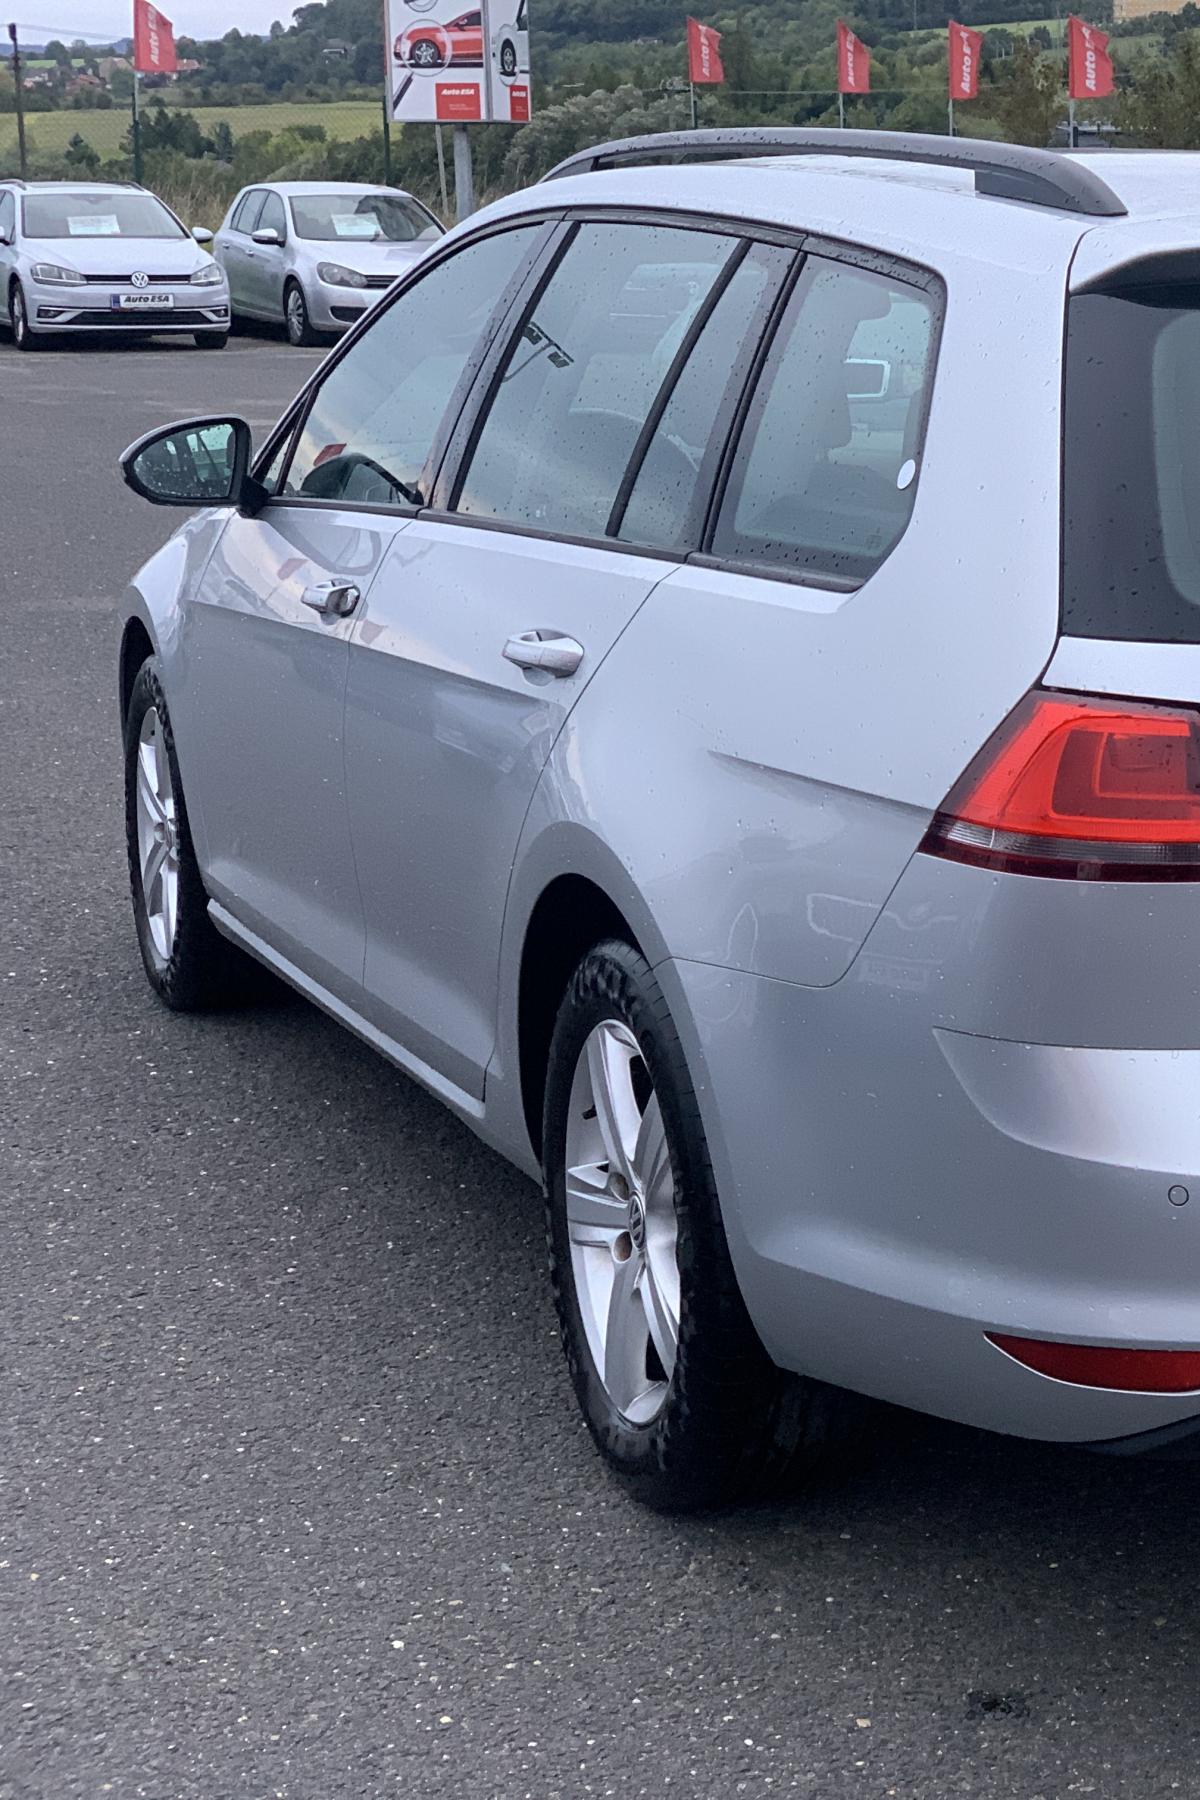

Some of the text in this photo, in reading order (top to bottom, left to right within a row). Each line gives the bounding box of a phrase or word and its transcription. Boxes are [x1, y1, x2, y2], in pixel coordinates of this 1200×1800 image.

[149, 31, 160, 65] Auto
[701, 45, 710, 77] Auto
[847, 51, 855, 87] Auto
[961, 56, 971, 93] Auto
[1085, 51, 1096, 91] Auto
[124, 295, 149, 303] Auto
